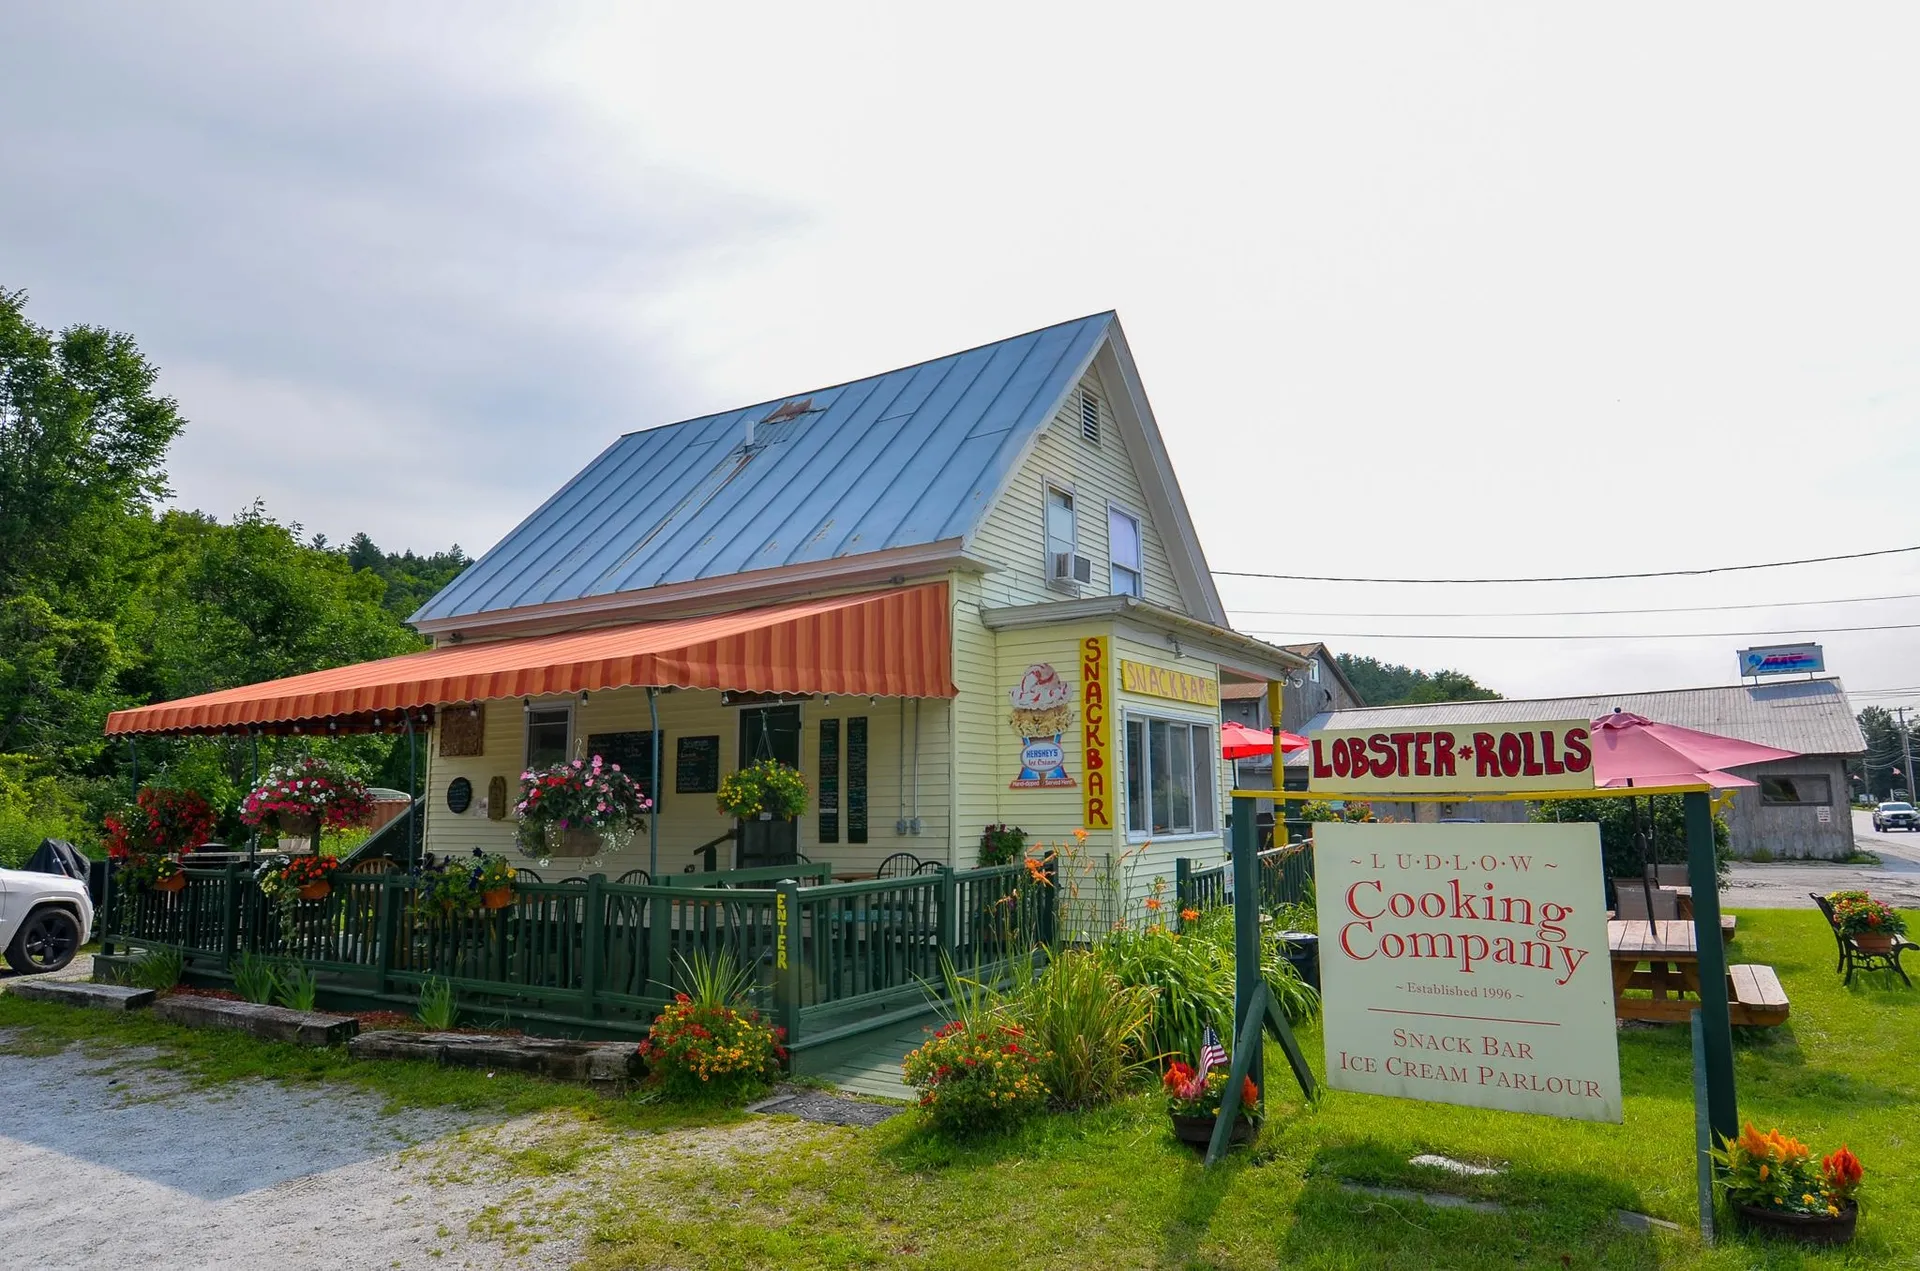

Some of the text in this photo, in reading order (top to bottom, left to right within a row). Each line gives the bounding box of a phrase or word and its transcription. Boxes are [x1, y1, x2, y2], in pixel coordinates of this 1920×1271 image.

[1026, 749, 1058, 758] HERSHEY'S
[1311, 728, 1592, 778] LOBSTER ROLLS
[777, 894, 788, 970] ENTER
[1345, 879, 1574, 943] Cooking
[1338, 920, 1589, 986] Company
[1407, 982, 1512, 1000] Established 1996
[1393, 1028, 1535, 1060] SNACK BAR
[1339, 1051, 1602, 1098] ICE CREAM PARLOUR
